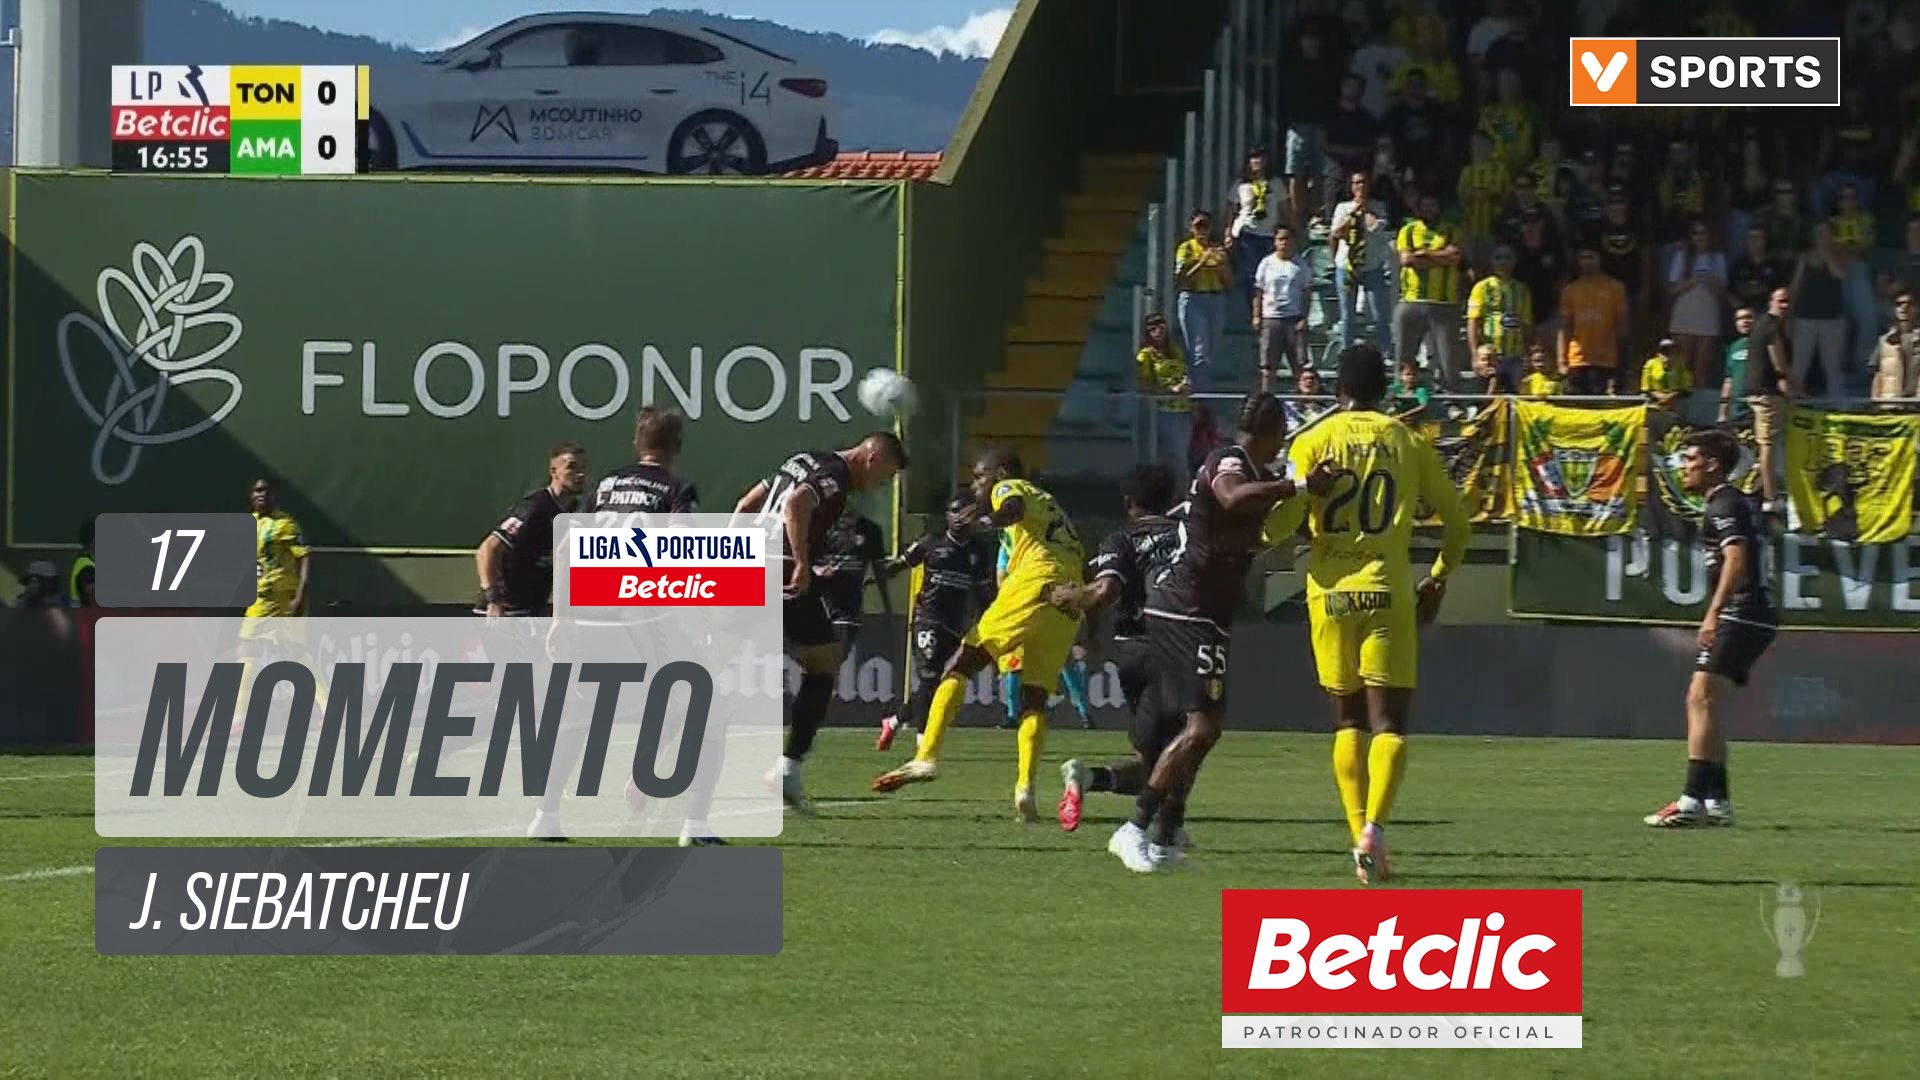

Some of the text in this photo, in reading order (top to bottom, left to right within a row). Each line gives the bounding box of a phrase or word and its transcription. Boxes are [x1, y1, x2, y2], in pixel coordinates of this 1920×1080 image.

[740, 72, 771, 106] i4
[530, 107, 643, 123] MCOUTINHO
[301, 341, 854, 422] FLOPONOR
[1323, 468, 1395, 534] 20
[1197, 645, 1227, 674] 55
